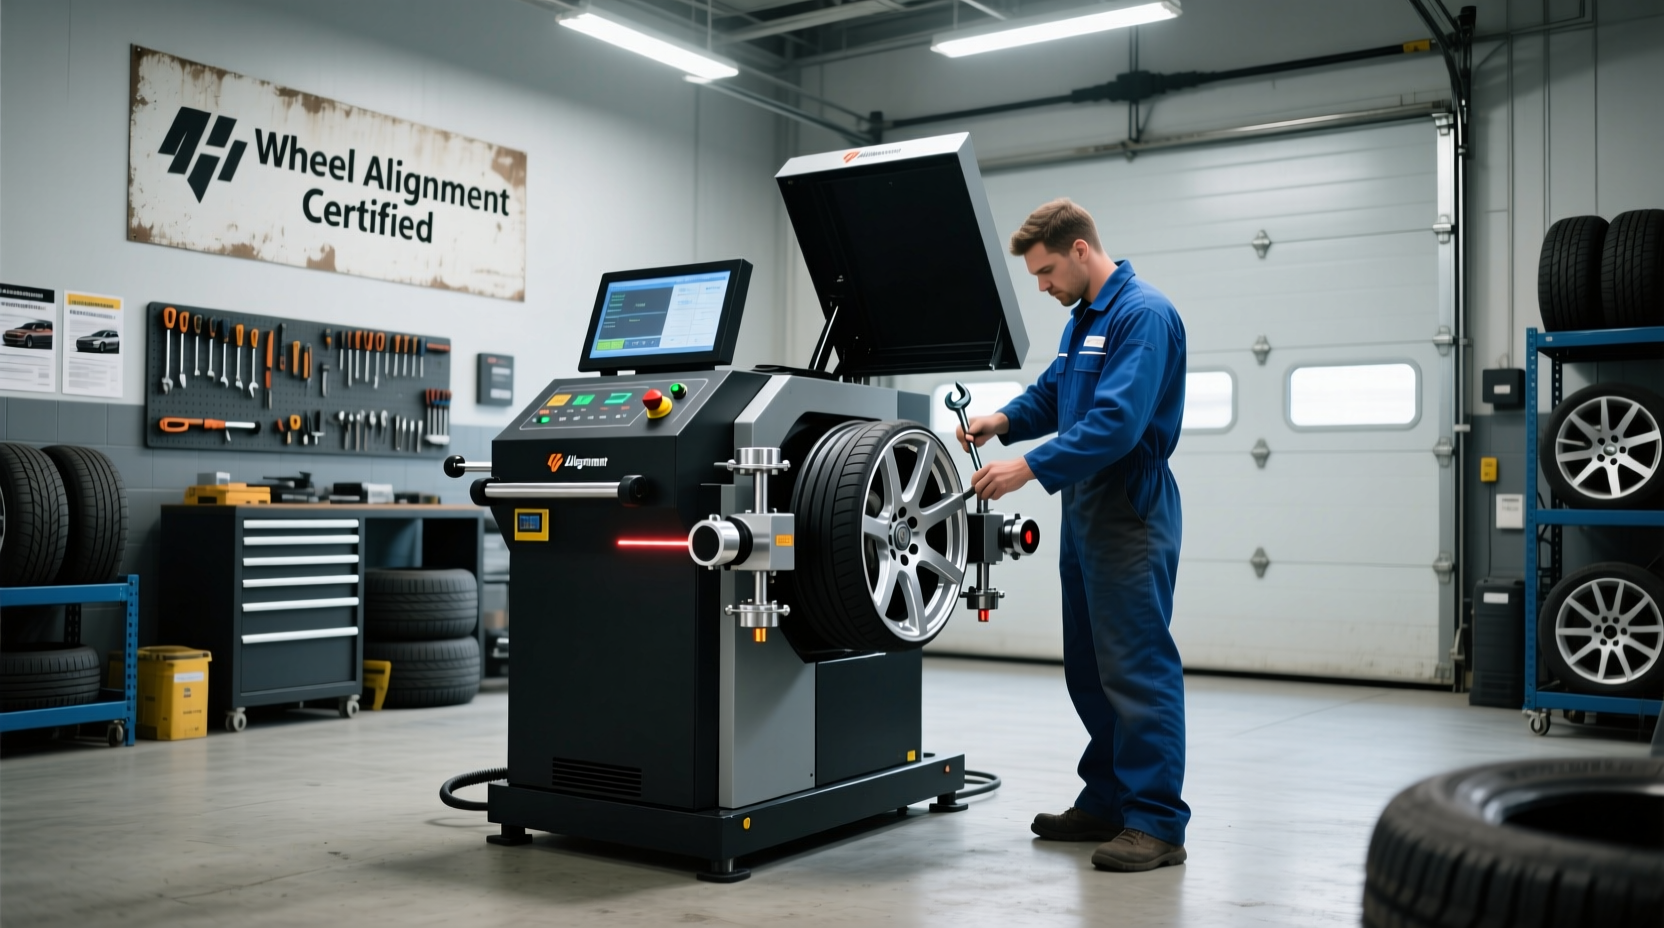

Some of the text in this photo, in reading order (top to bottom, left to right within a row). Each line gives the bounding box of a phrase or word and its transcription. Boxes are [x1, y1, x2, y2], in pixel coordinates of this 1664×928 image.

[254, 128, 510, 217] Wheel Alignment
[302, 188, 433, 244] Certified
